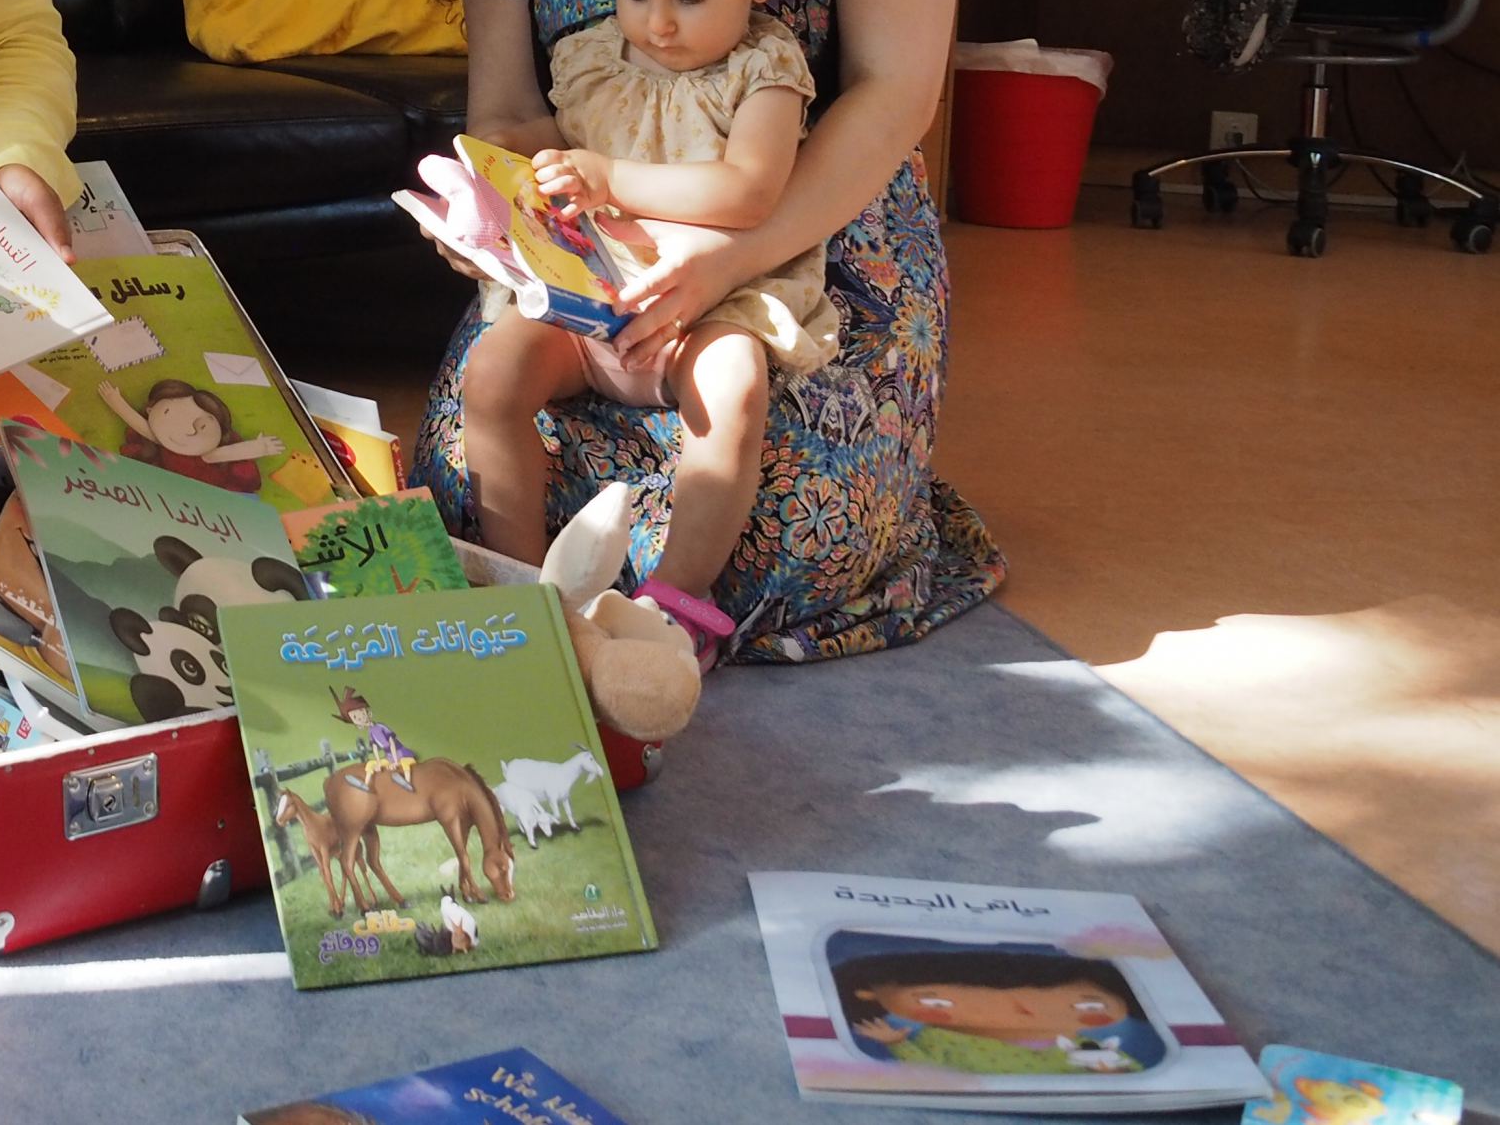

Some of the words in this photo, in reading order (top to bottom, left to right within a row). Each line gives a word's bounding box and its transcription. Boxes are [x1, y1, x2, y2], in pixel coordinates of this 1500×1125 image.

[110, 276, 186, 304] رسائل
[64, 468, 152, 513] الصغير
[298, 523, 389, 568] الأش
[834, 886, 956, 912] الجديدة
[964, 899, 1050, 917] حياتي
